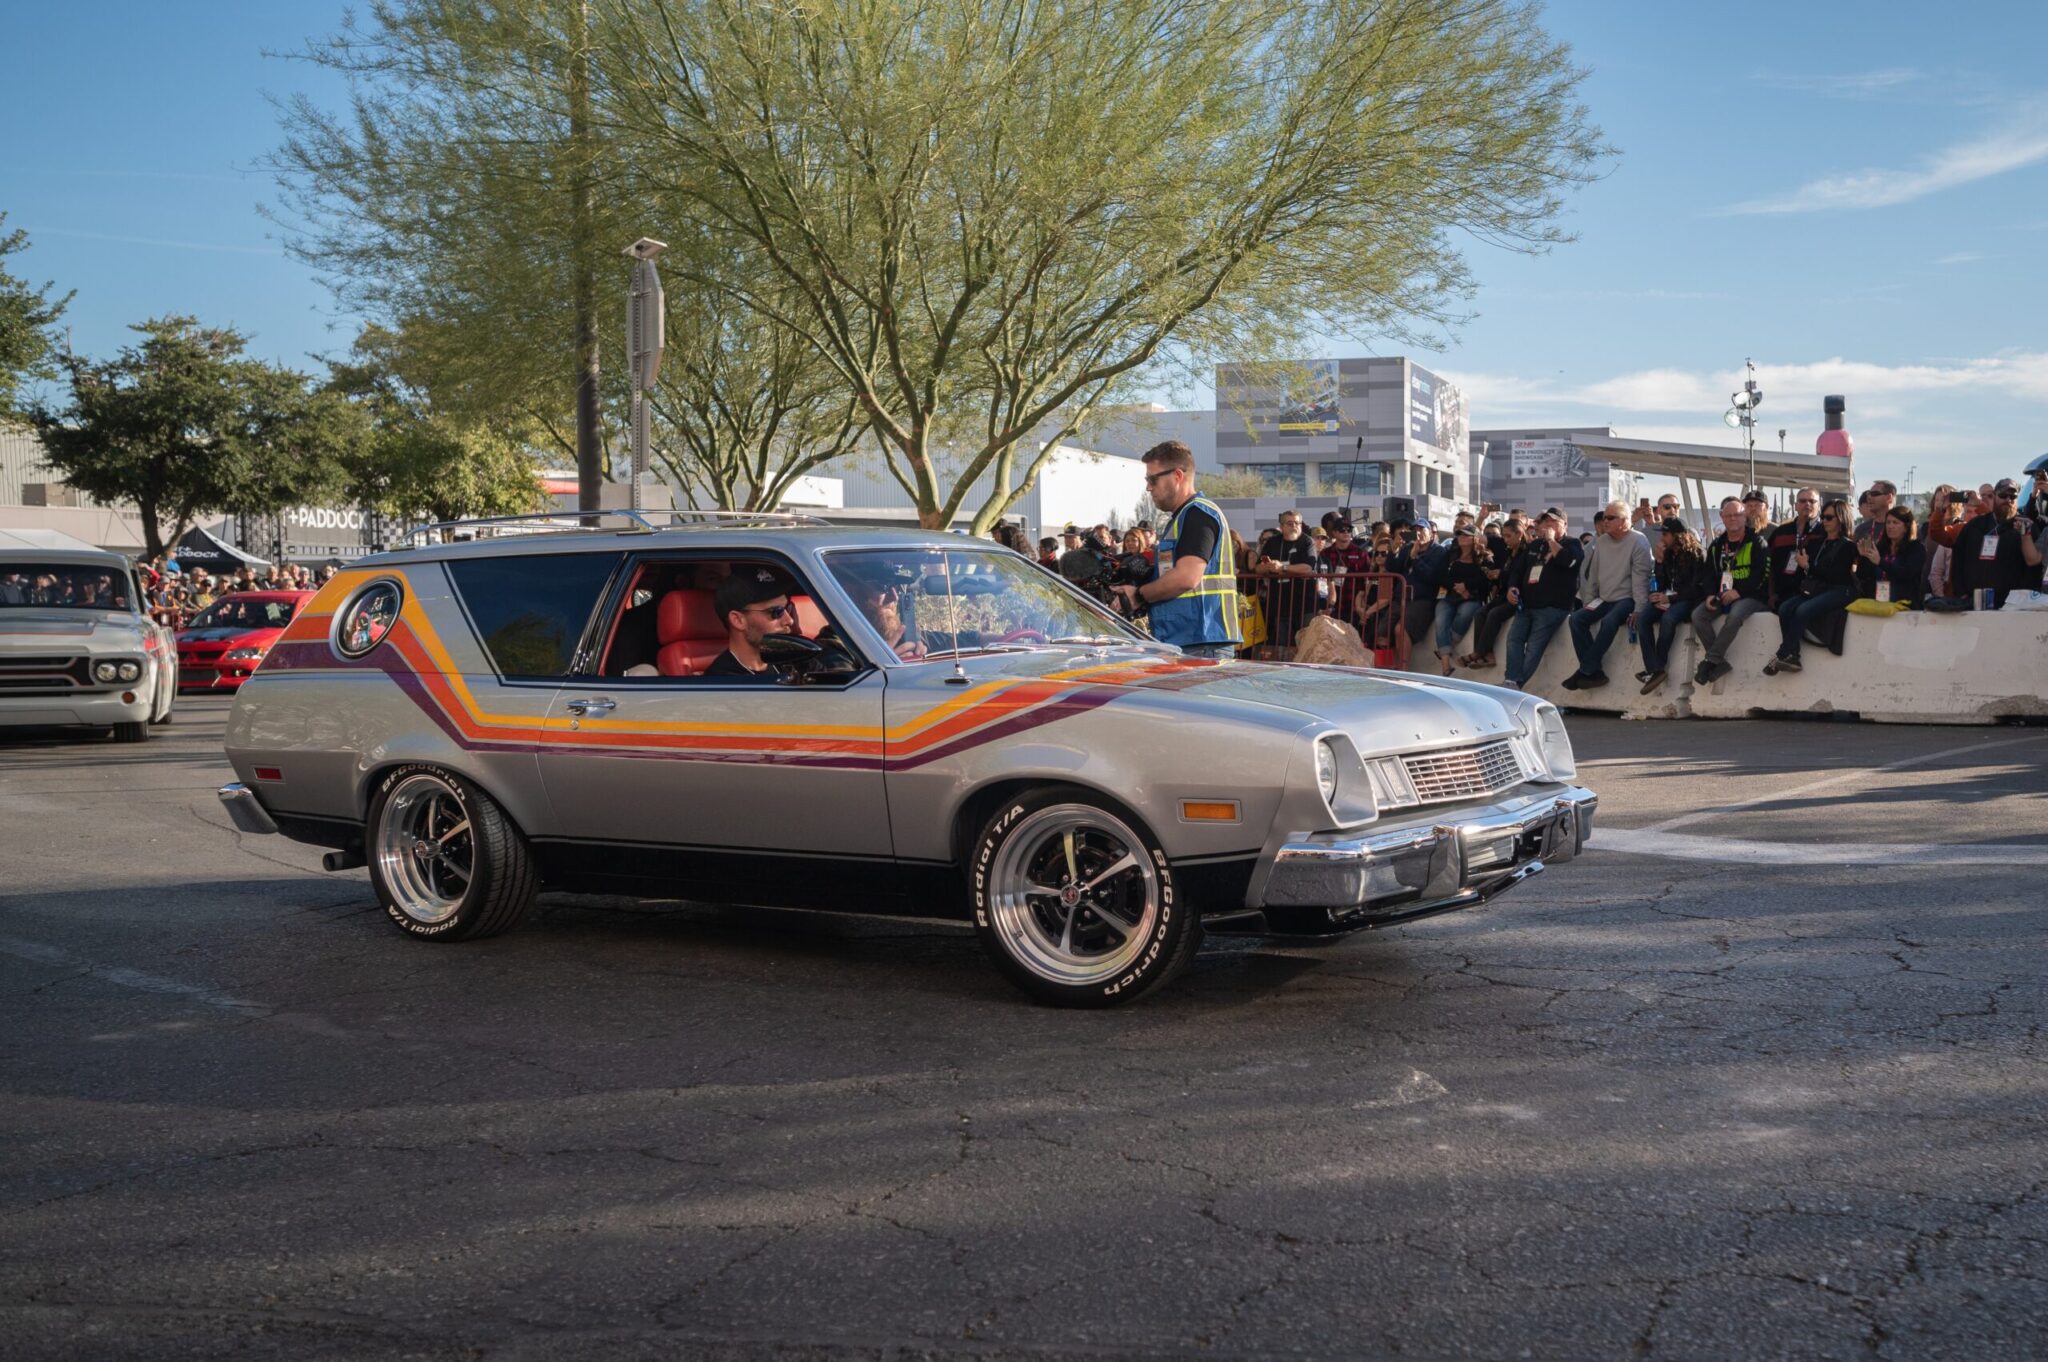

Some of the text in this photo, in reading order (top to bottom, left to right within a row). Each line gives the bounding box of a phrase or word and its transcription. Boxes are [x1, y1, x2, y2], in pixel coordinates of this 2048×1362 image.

[382, 764, 466, 801] BFGoodrich
[976, 804, 1024, 927] Radial T/A
[388, 904, 458, 935] Radial T/A
[1104, 849, 1173, 996] BFGoodrich
